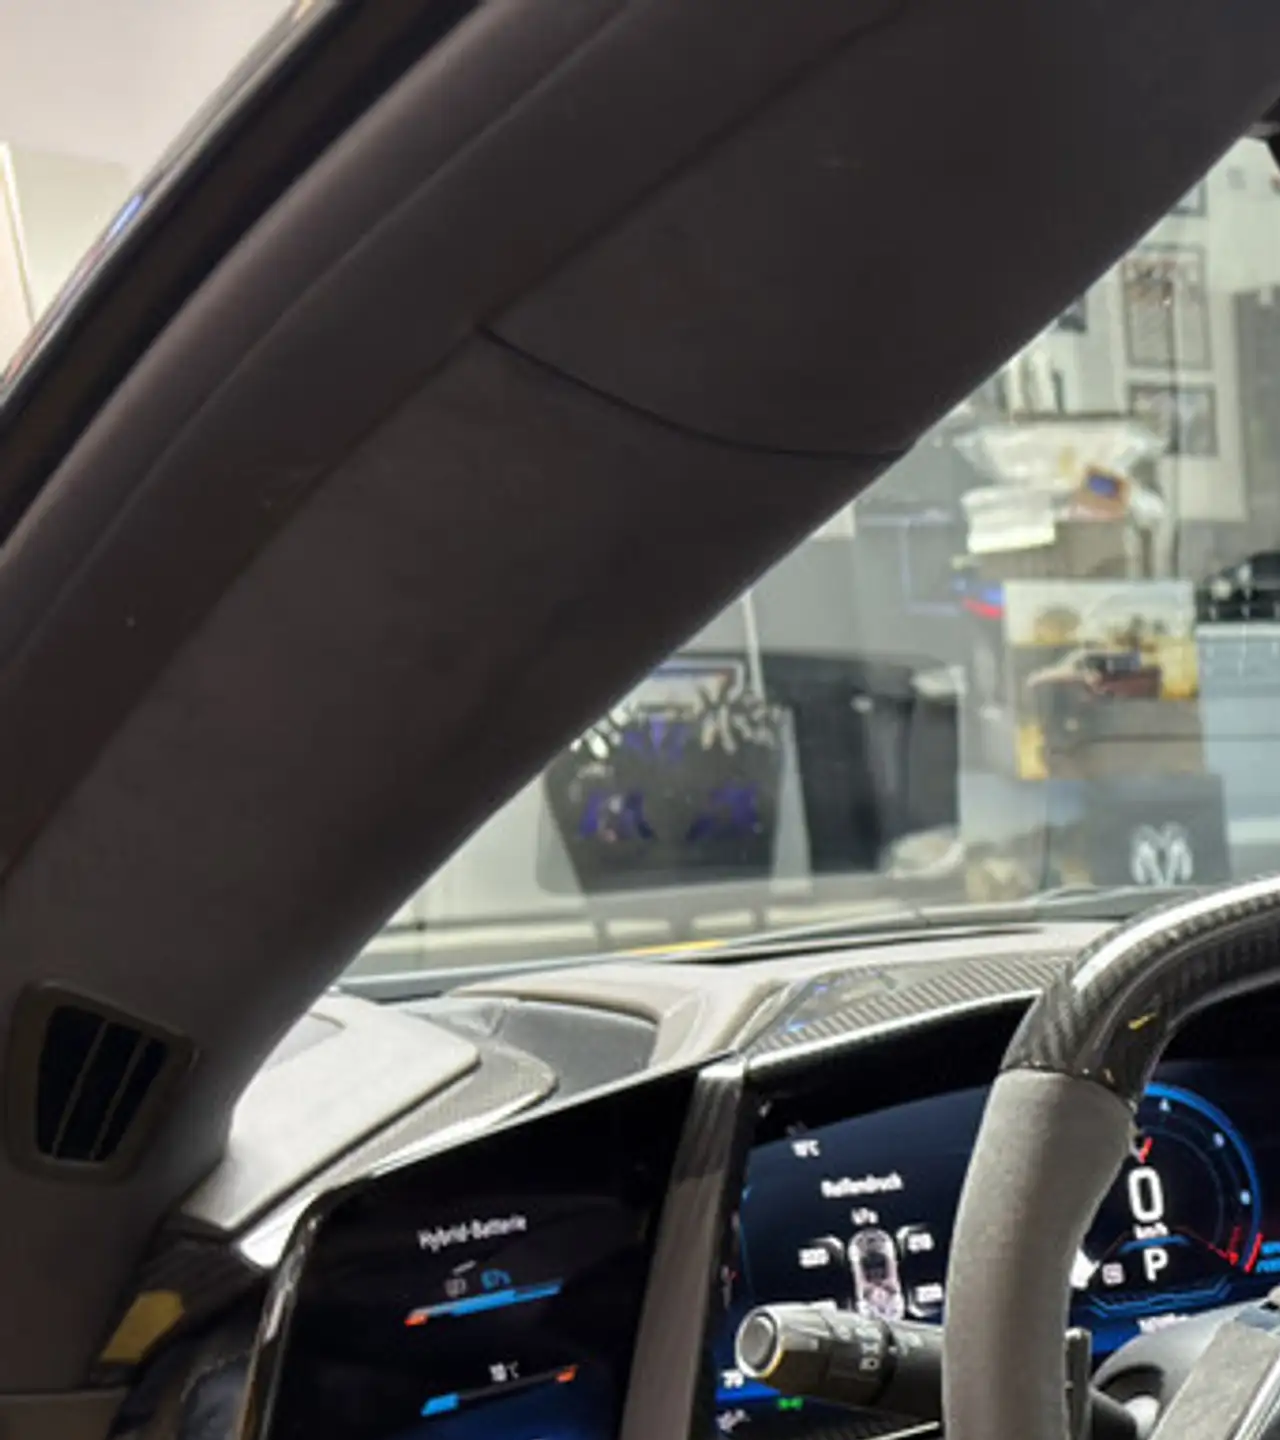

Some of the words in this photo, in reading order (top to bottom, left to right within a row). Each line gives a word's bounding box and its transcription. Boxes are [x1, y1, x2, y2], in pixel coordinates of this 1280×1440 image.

[1127, 1166, 1164, 1223] 0
[416, 1213, 528, 1252] Hybrid-Batterie
[1142, 1248, 1170, 1281] P
